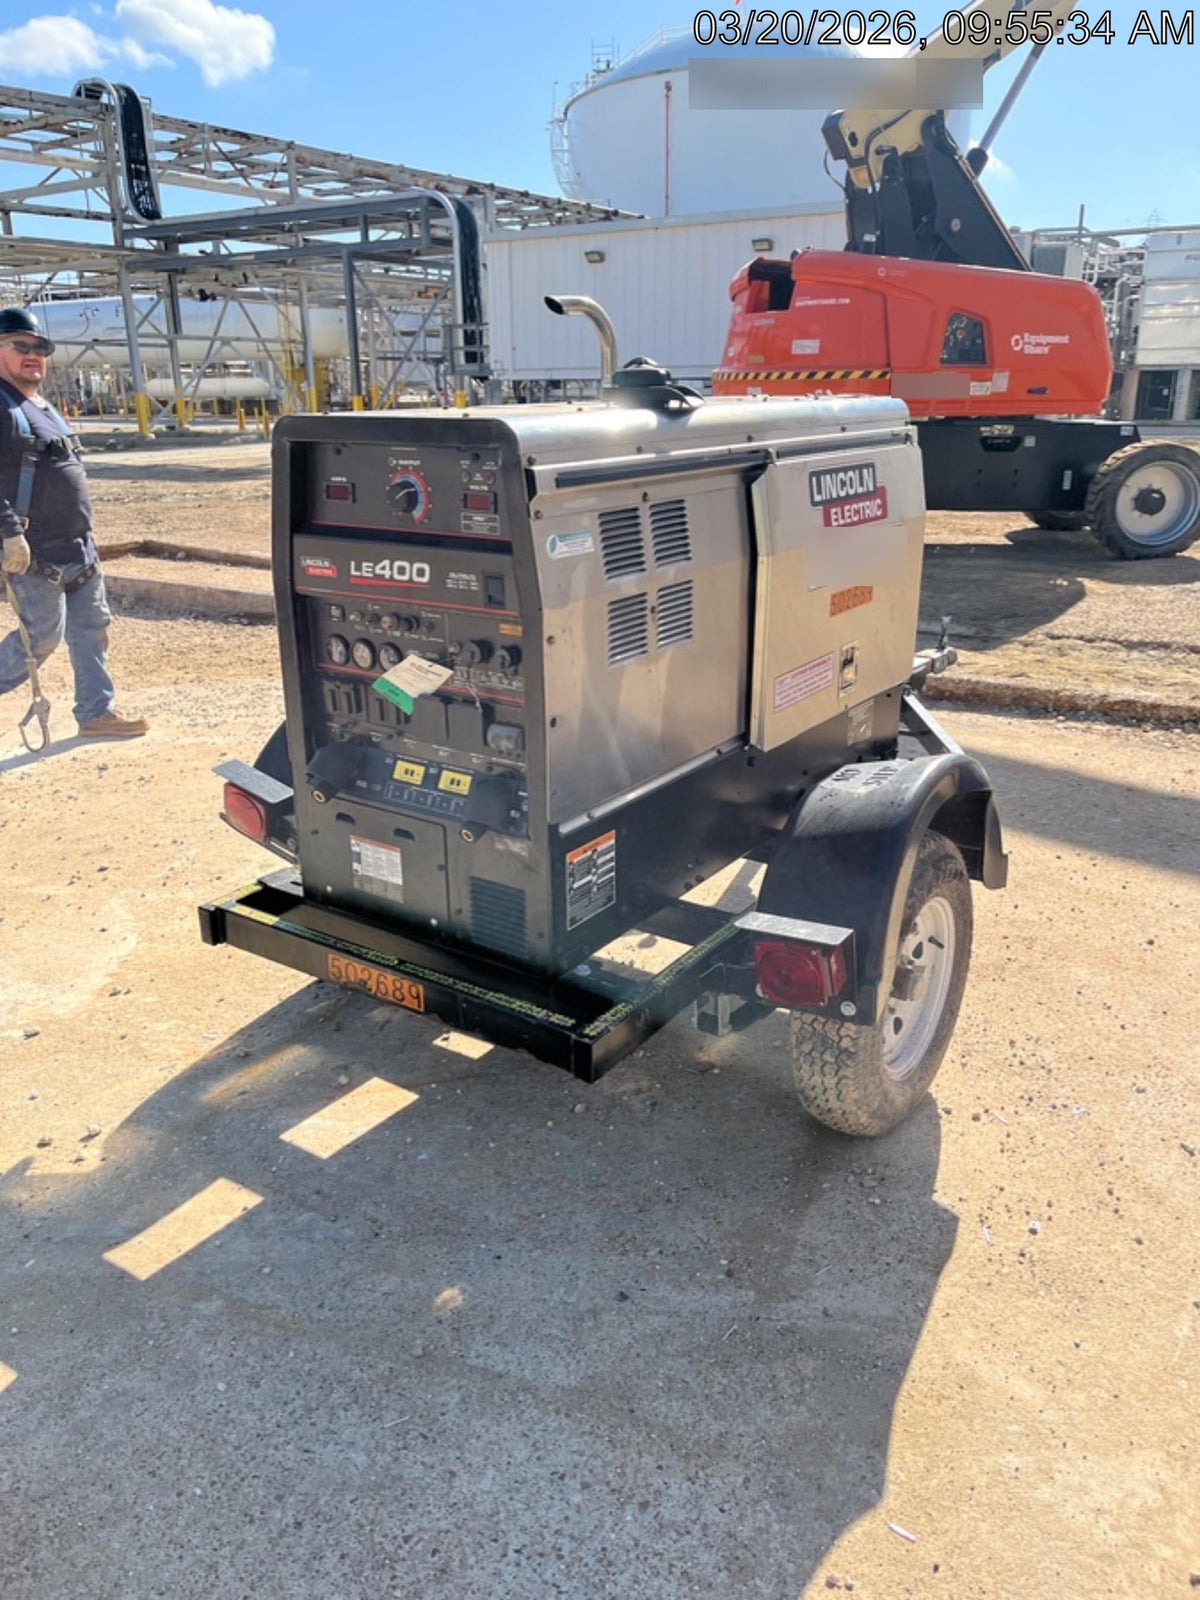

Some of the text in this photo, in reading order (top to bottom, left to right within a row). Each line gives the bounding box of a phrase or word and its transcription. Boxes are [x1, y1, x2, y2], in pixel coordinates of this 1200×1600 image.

[1023, 333, 1070, 346] Equipment
[1023, 344, 1051, 355] Share
[811, 467, 875, 502] LINCOLN
[830, 498, 883, 527] ELECTRIC
[300, 558, 331, 568] LINCOLN
[350, 559, 430, 583] LE400
